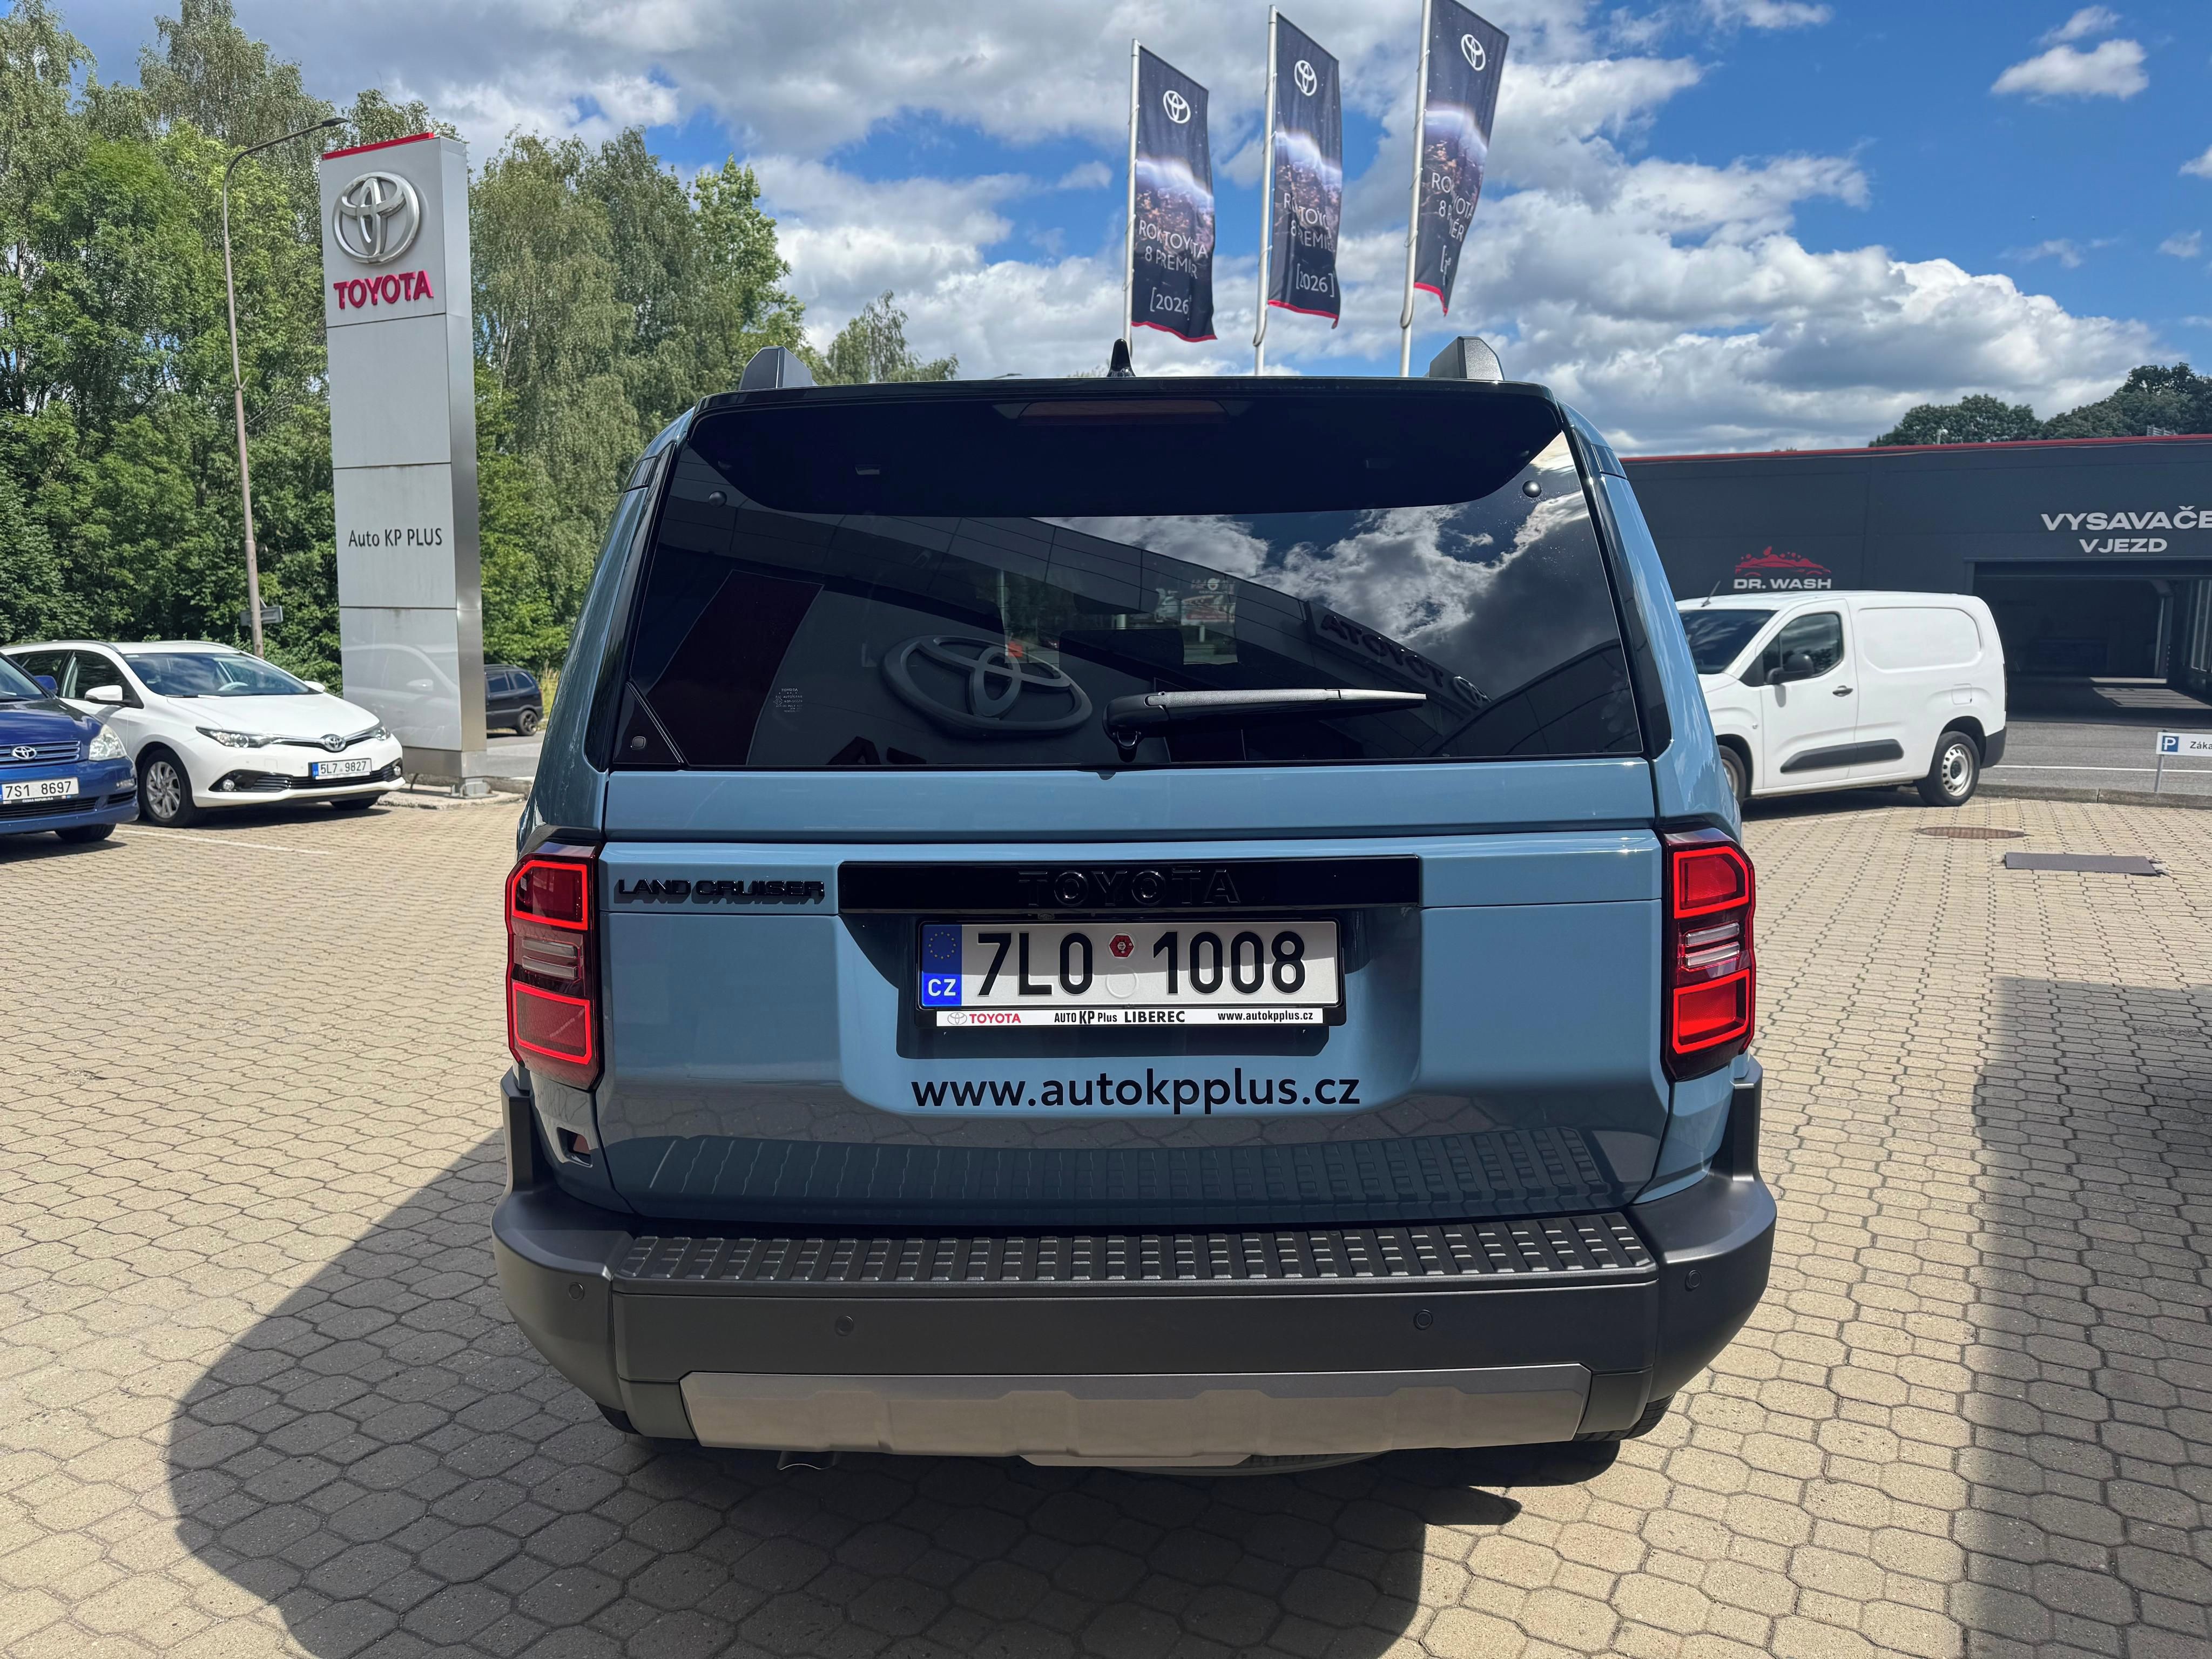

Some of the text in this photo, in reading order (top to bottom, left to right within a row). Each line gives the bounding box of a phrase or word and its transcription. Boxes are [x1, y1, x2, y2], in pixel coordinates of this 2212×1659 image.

[1145, 246, 1153, 262] 8
[333, 269, 434, 309] TOYOTA
[2040, 505, 2212, 531] VYSAVAČE
[348, 528, 443, 547] Auto KP PLUS
[2079, 538, 2168, 553] VJEZD
[1734, 578, 1832, 589] DR. WASH
[320, 763, 338, 774] 5L7
[345, 760, 367, 772] 9827
[5, 781, 71, 798] 7S1 8697
[618, 878, 825, 897] LAND CRUISER
[1019, 868, 1242, 907] TOYOTA
[976, 930, 1306, 996] 7L0 1008
[927, 978, 957, 997] CZ
[969, 1010, 1313, 1024] TOYOTA AUTO KP Plus LIBEREC www.autokpplus.cz
[912, 1068, 1361, 1115] www.autokpplus.cz
